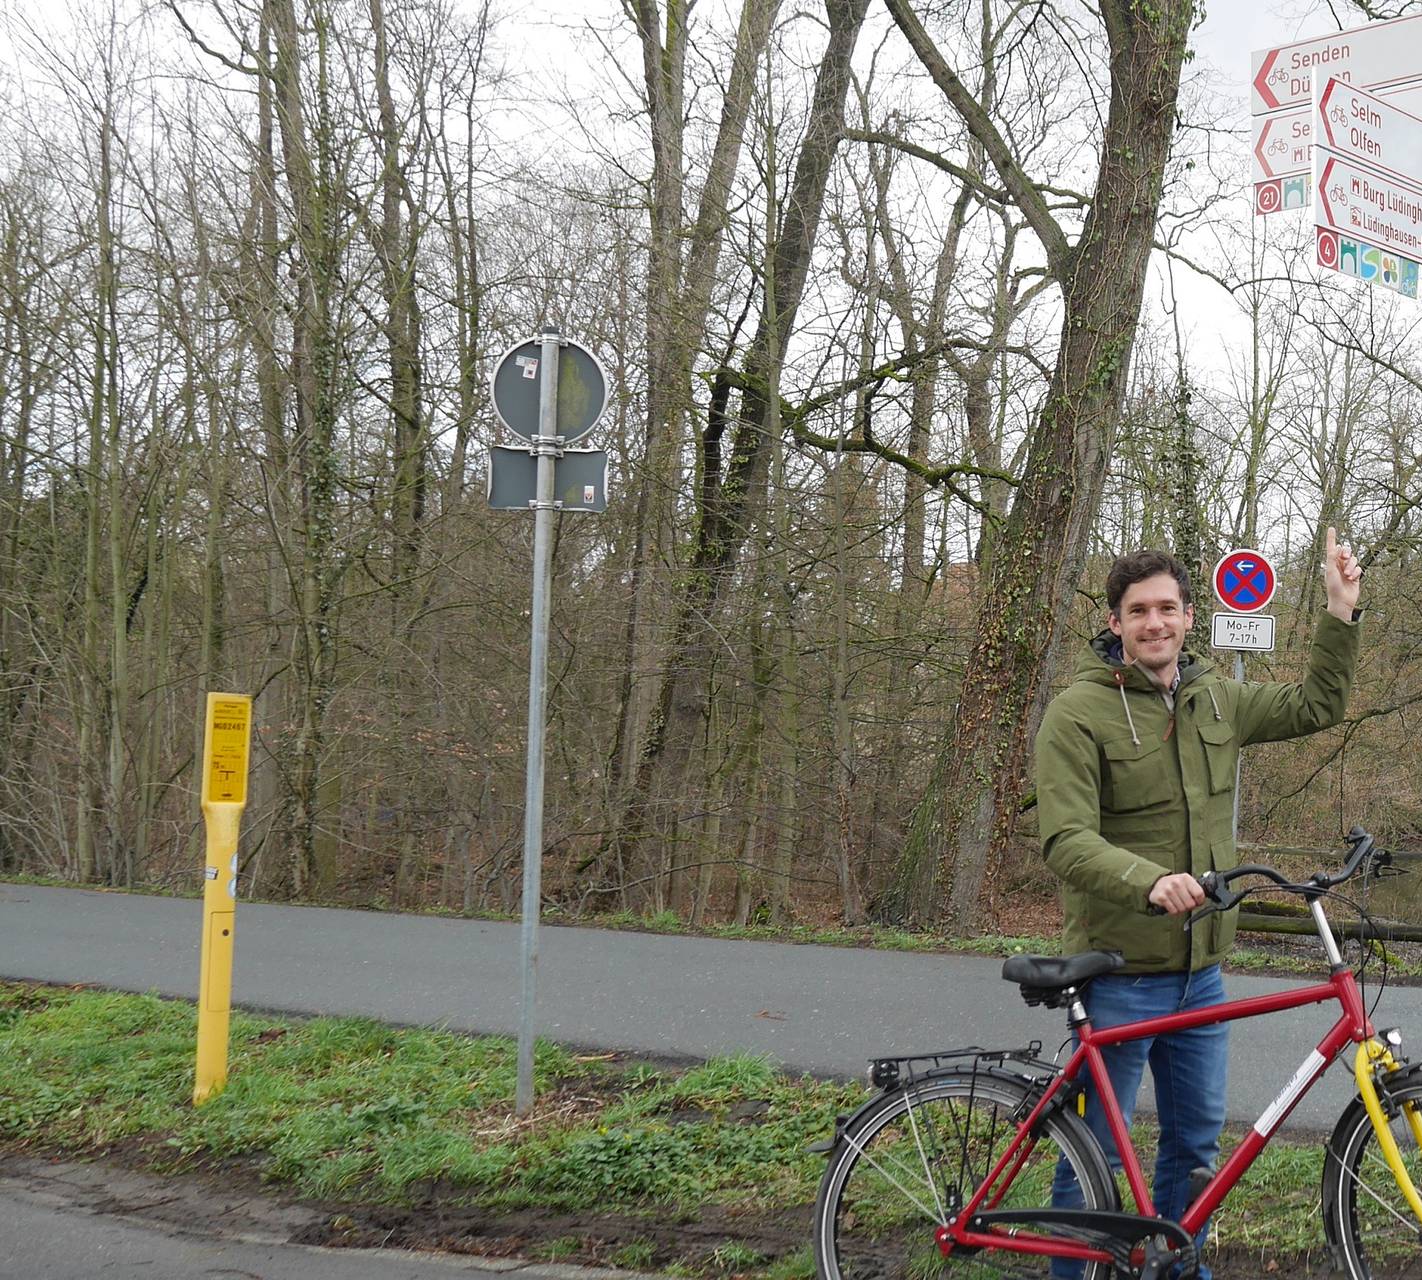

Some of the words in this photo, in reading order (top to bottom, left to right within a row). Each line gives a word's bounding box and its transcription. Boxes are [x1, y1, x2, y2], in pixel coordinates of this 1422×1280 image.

[1291, 45, 1350, 70] Senden
[1351, 98, 1382, 129] Selm
[1351, 127, 1381, 158] Olfen
[1263, 192, 1274, 205] 21
[1363, 180, 1385, 212] Burg
[1324, 242, 1331, 258] 4
[1227, 620, 1260, 631] Mo-Fr
